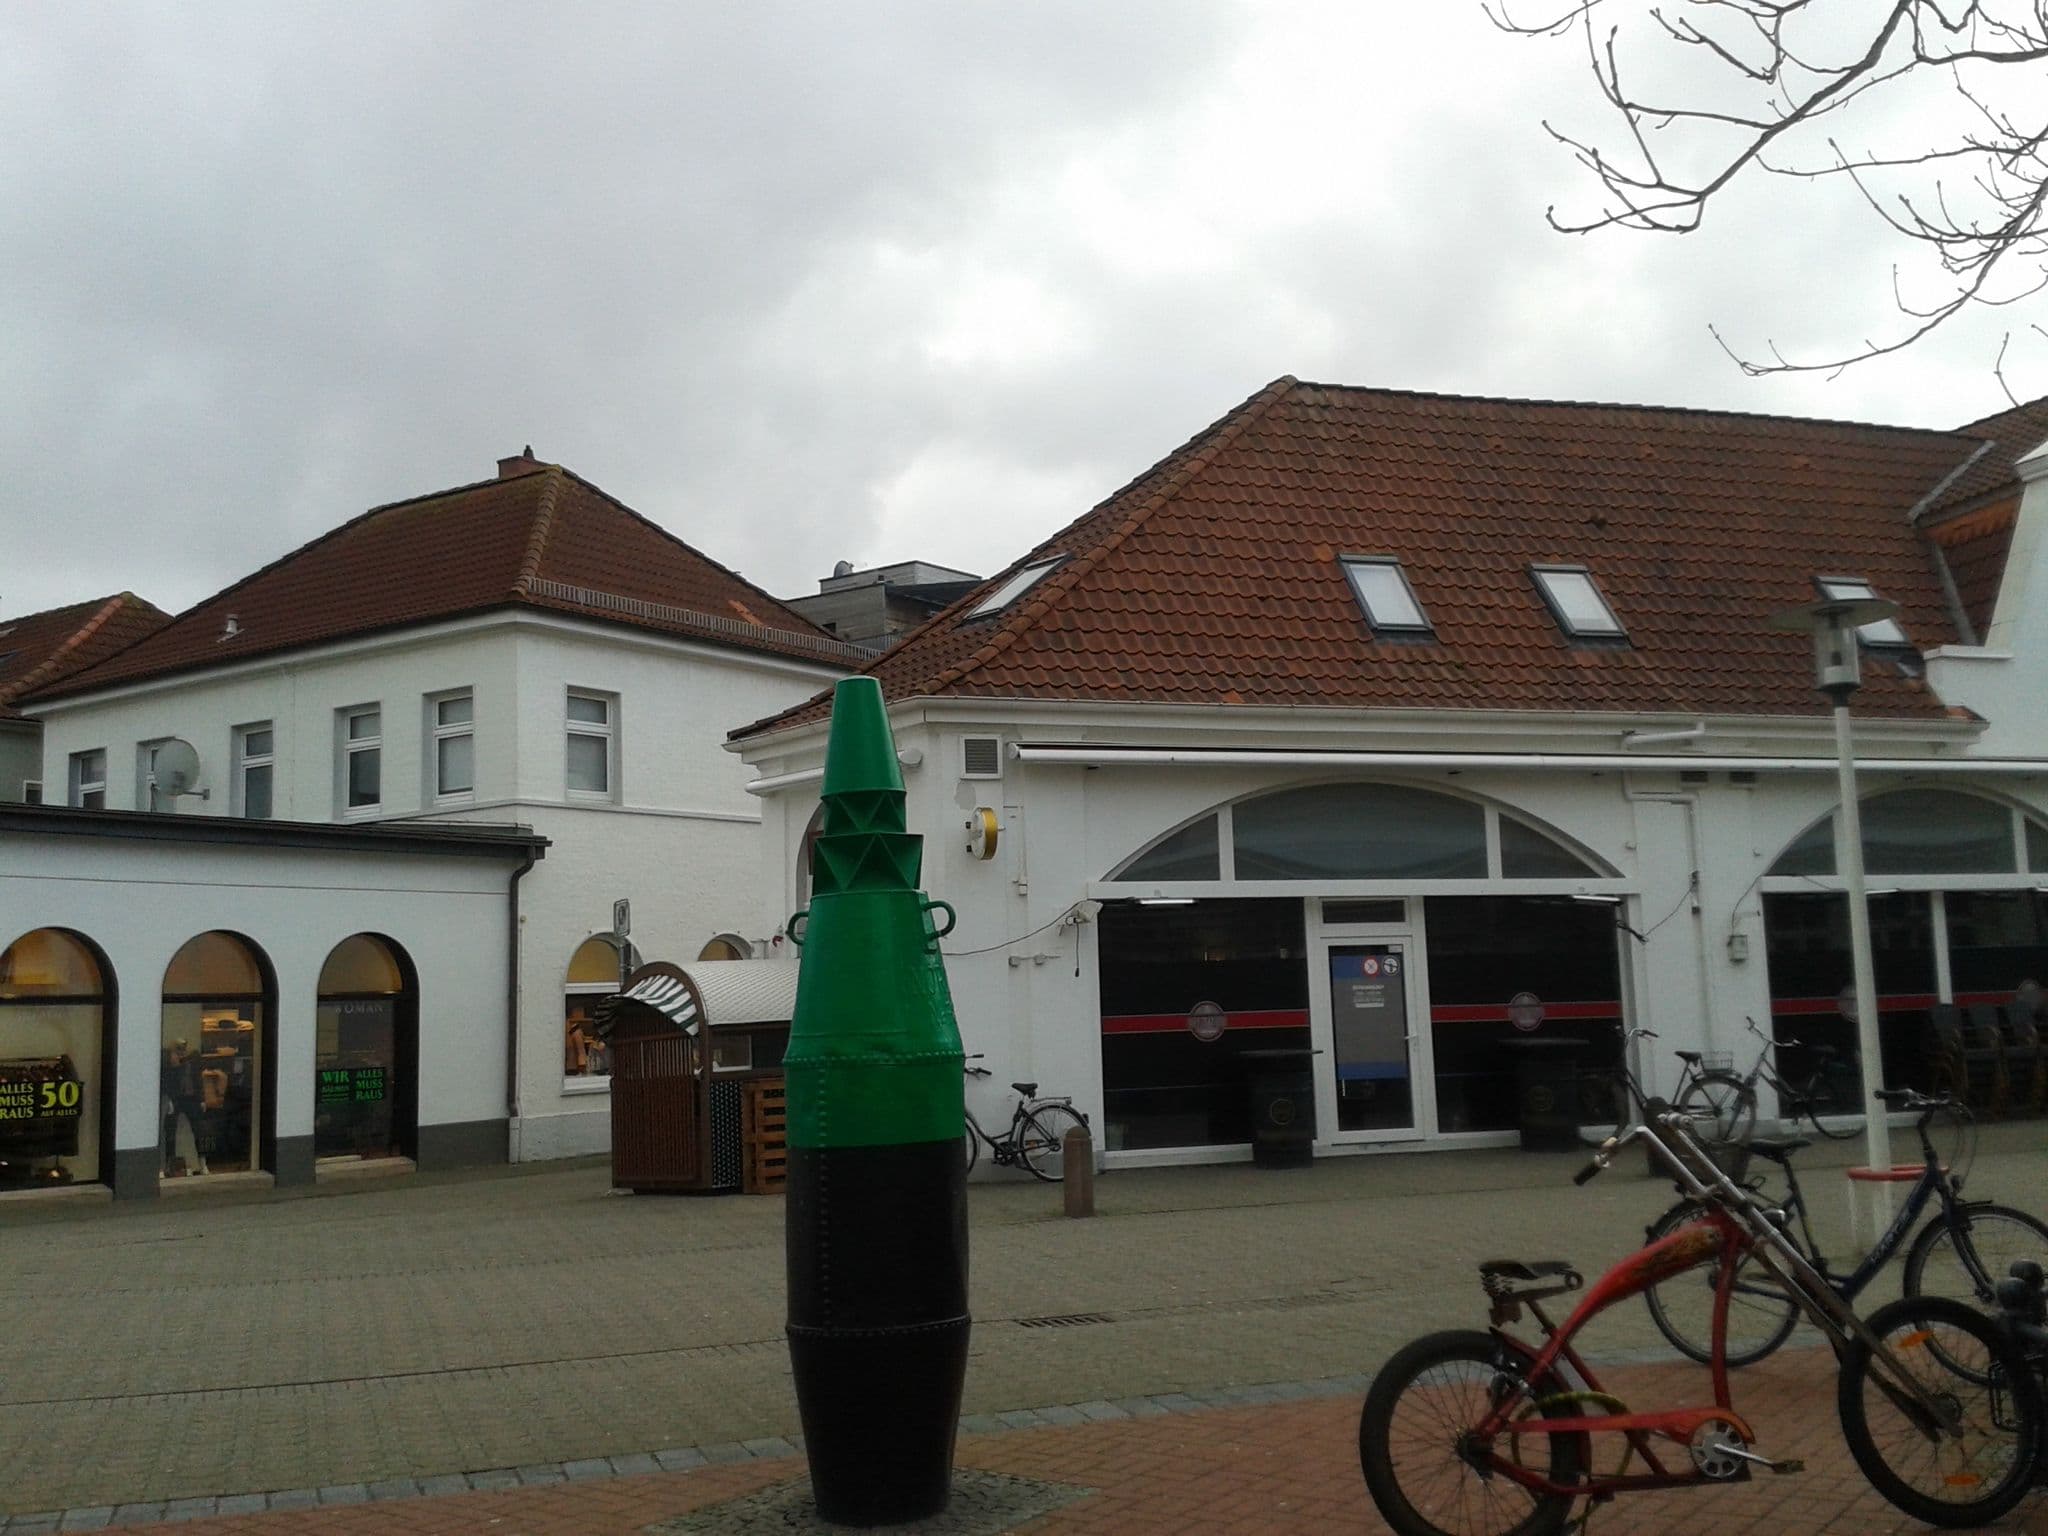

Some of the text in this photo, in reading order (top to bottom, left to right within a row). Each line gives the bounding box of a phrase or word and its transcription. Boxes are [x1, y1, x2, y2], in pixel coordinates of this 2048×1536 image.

[322, 1071, 350, 1084] WIR
[356, 1069, 383, 1079] ALLES
[0, 1082, 34, 1095] ALLES
[356, 1079, 384, 1090] MUSS
[41, 1081, 79, 1108] 50
[356, 1089, 384, 1100] RAUS
[0, 1095, 34, 1107] MUSS
[0, 1107, 34, 1119] RAUS
